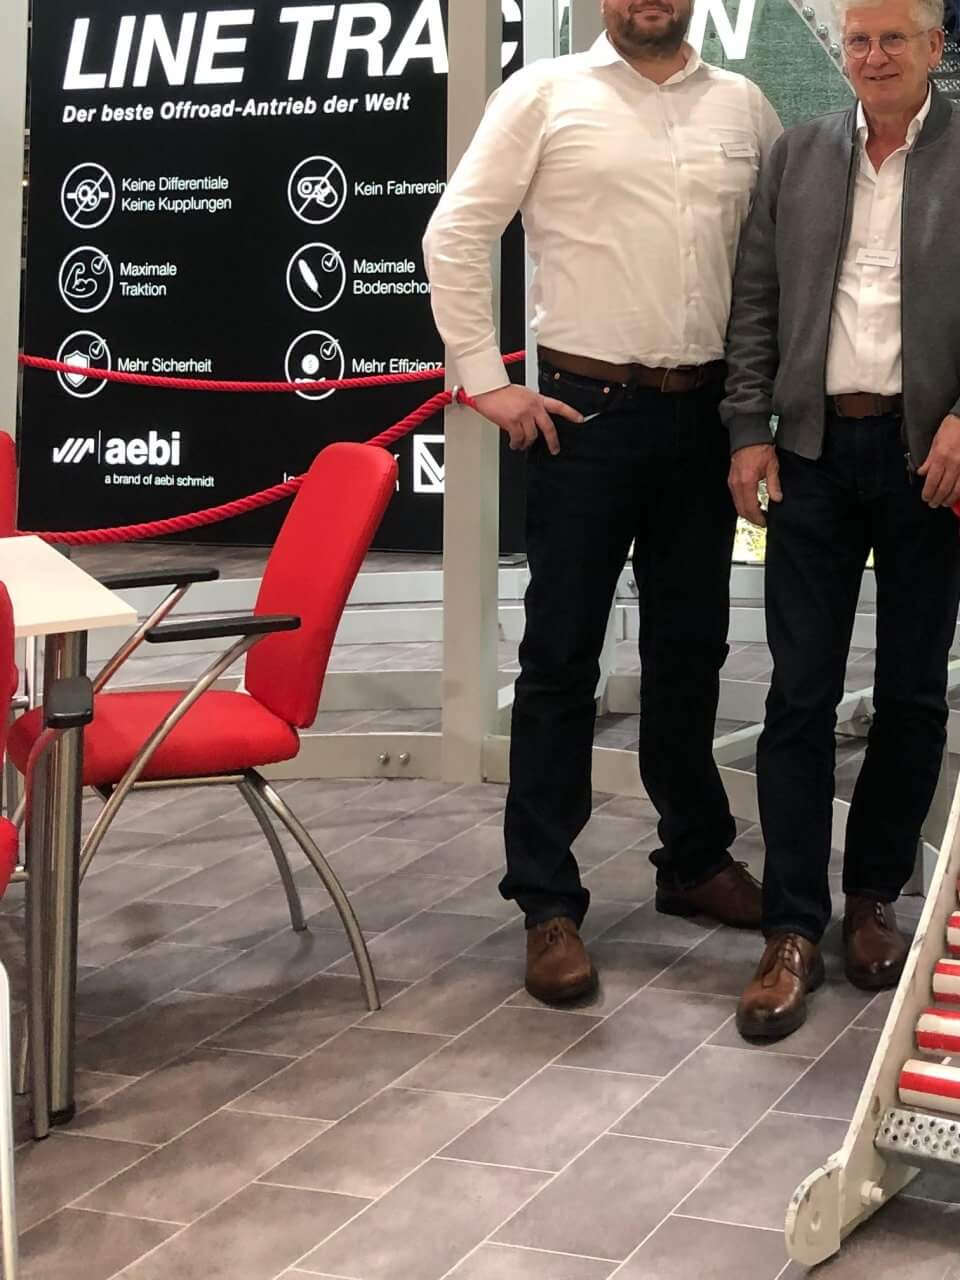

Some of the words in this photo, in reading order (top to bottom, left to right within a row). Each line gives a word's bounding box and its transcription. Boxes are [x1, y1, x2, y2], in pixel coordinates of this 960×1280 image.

[62, 8, 255, 90] LINE
[62, 104, 96, 123] Der
[101, 103, 153, 122] beste
[160, 96, 317, 120] Offroad-Antrieb
[324, 95, 358, 114] der
[364, 92, 411, 111] Welt
[122, 177, 155, 192] Keine
[159, 176, 229, 191] Differentiale
[354, 181, 383, 196] Kein
[387, 180, 447, 195] Fahrerein
[121, 197, 155, 212] Keine
[158, 197, 232, 213] Kupplungen
[120, 262, 177, 277] Maximale
[353, 259, 416, 274] Maximale
[120, 282, 167, 297] Traktion
[118, 357, 149, 372] Mehr
[152, 357, 212, 373] Sicherheit
[352, 358, 385, 374] Mehr
[104, 430, 181, 466] aebi
[104, 475, 111, 484] a
[113, 474, 141, 485] brand
[143, 474, 153, 485] of
[154, 474, 174, 486] aebi
[176, 475, 215, 487] schmidt
